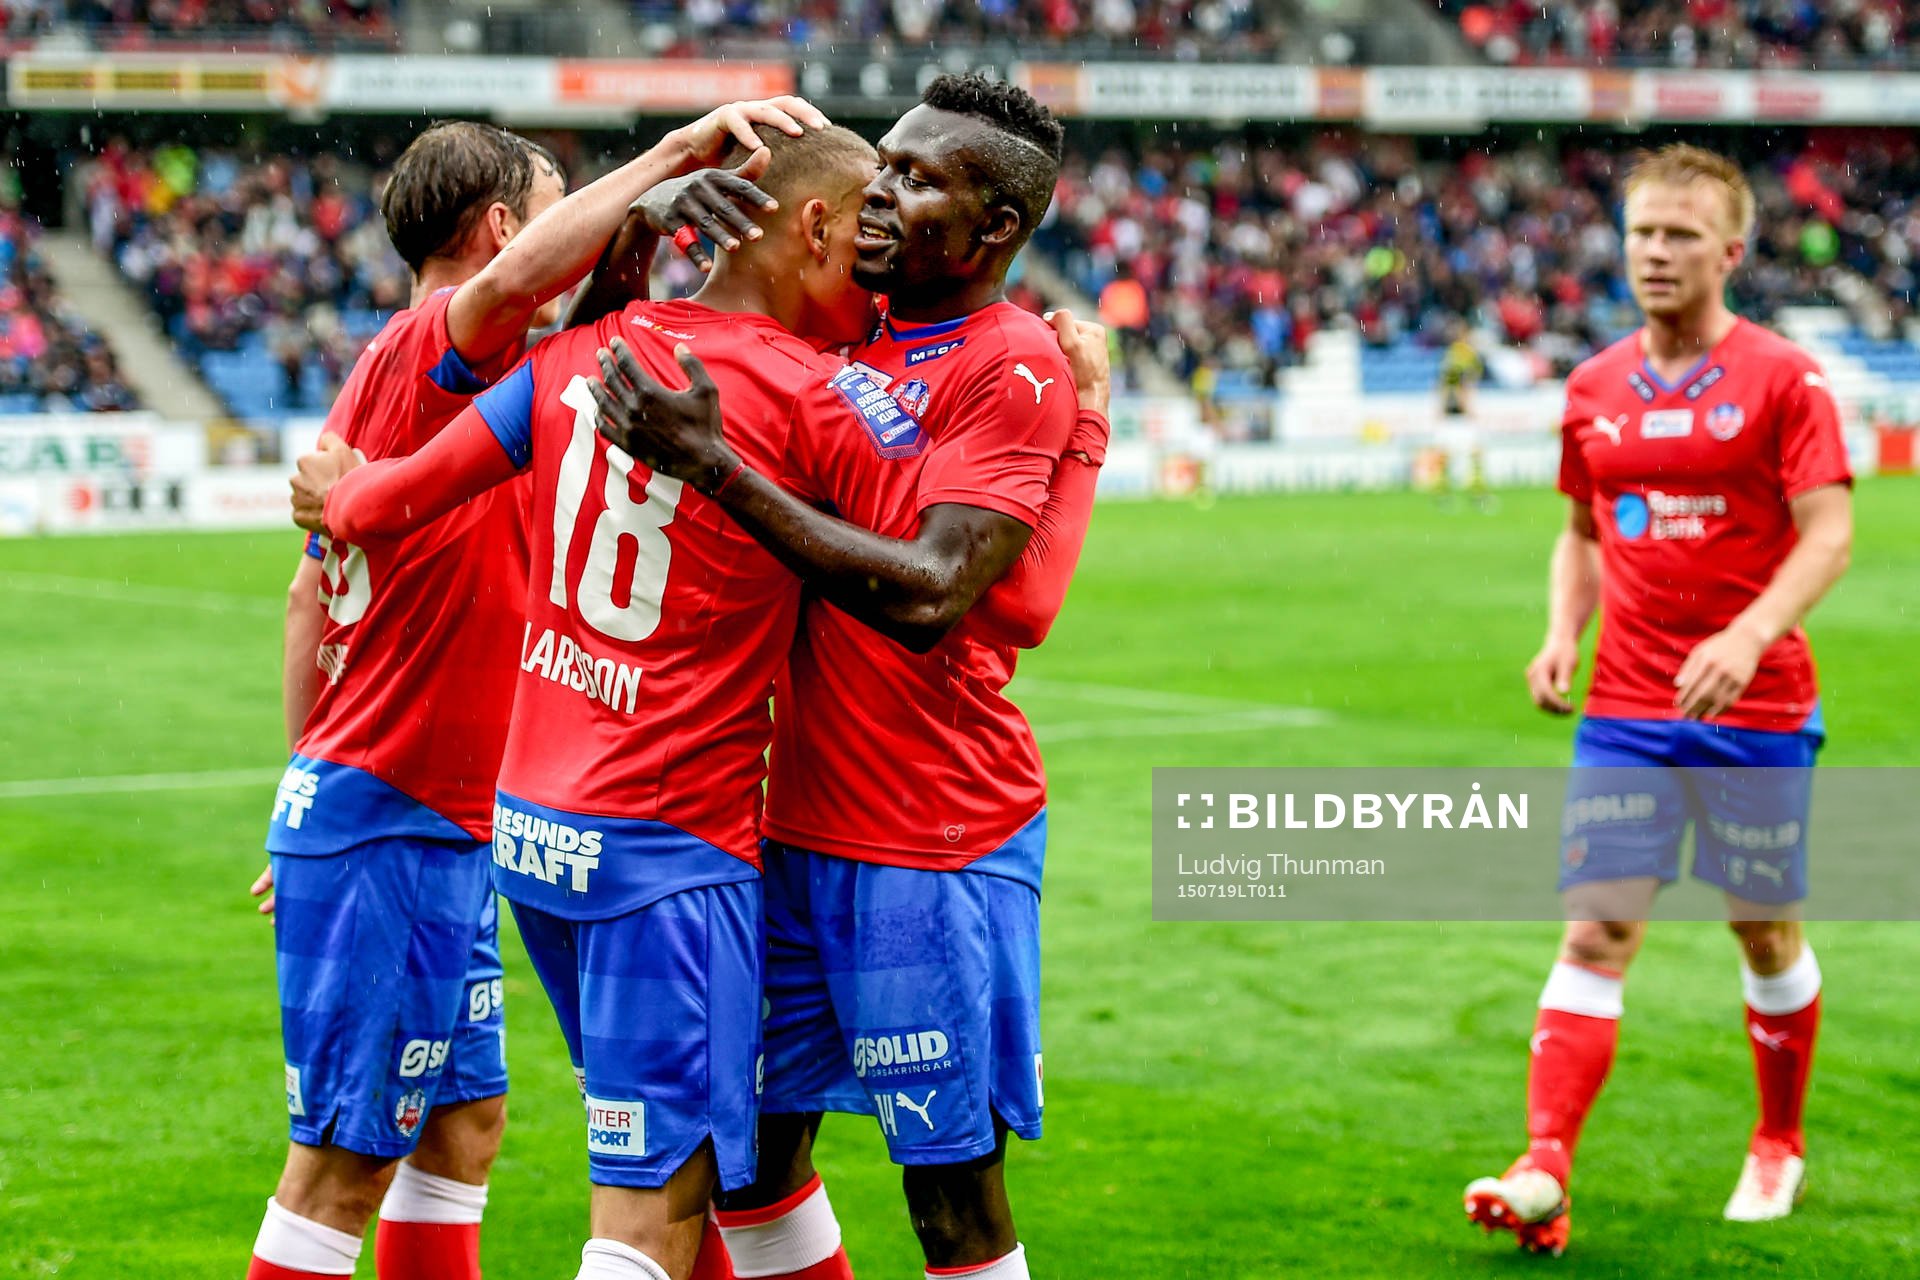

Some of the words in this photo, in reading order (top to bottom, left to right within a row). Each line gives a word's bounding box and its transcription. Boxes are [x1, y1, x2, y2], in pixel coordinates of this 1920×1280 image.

[550, 374, 684, 642] 18
[520, 621, 643, 714] LARSSON
[866, 1030, 949, 1068] SOLID
[874, 1094, 898, 1136] 14
